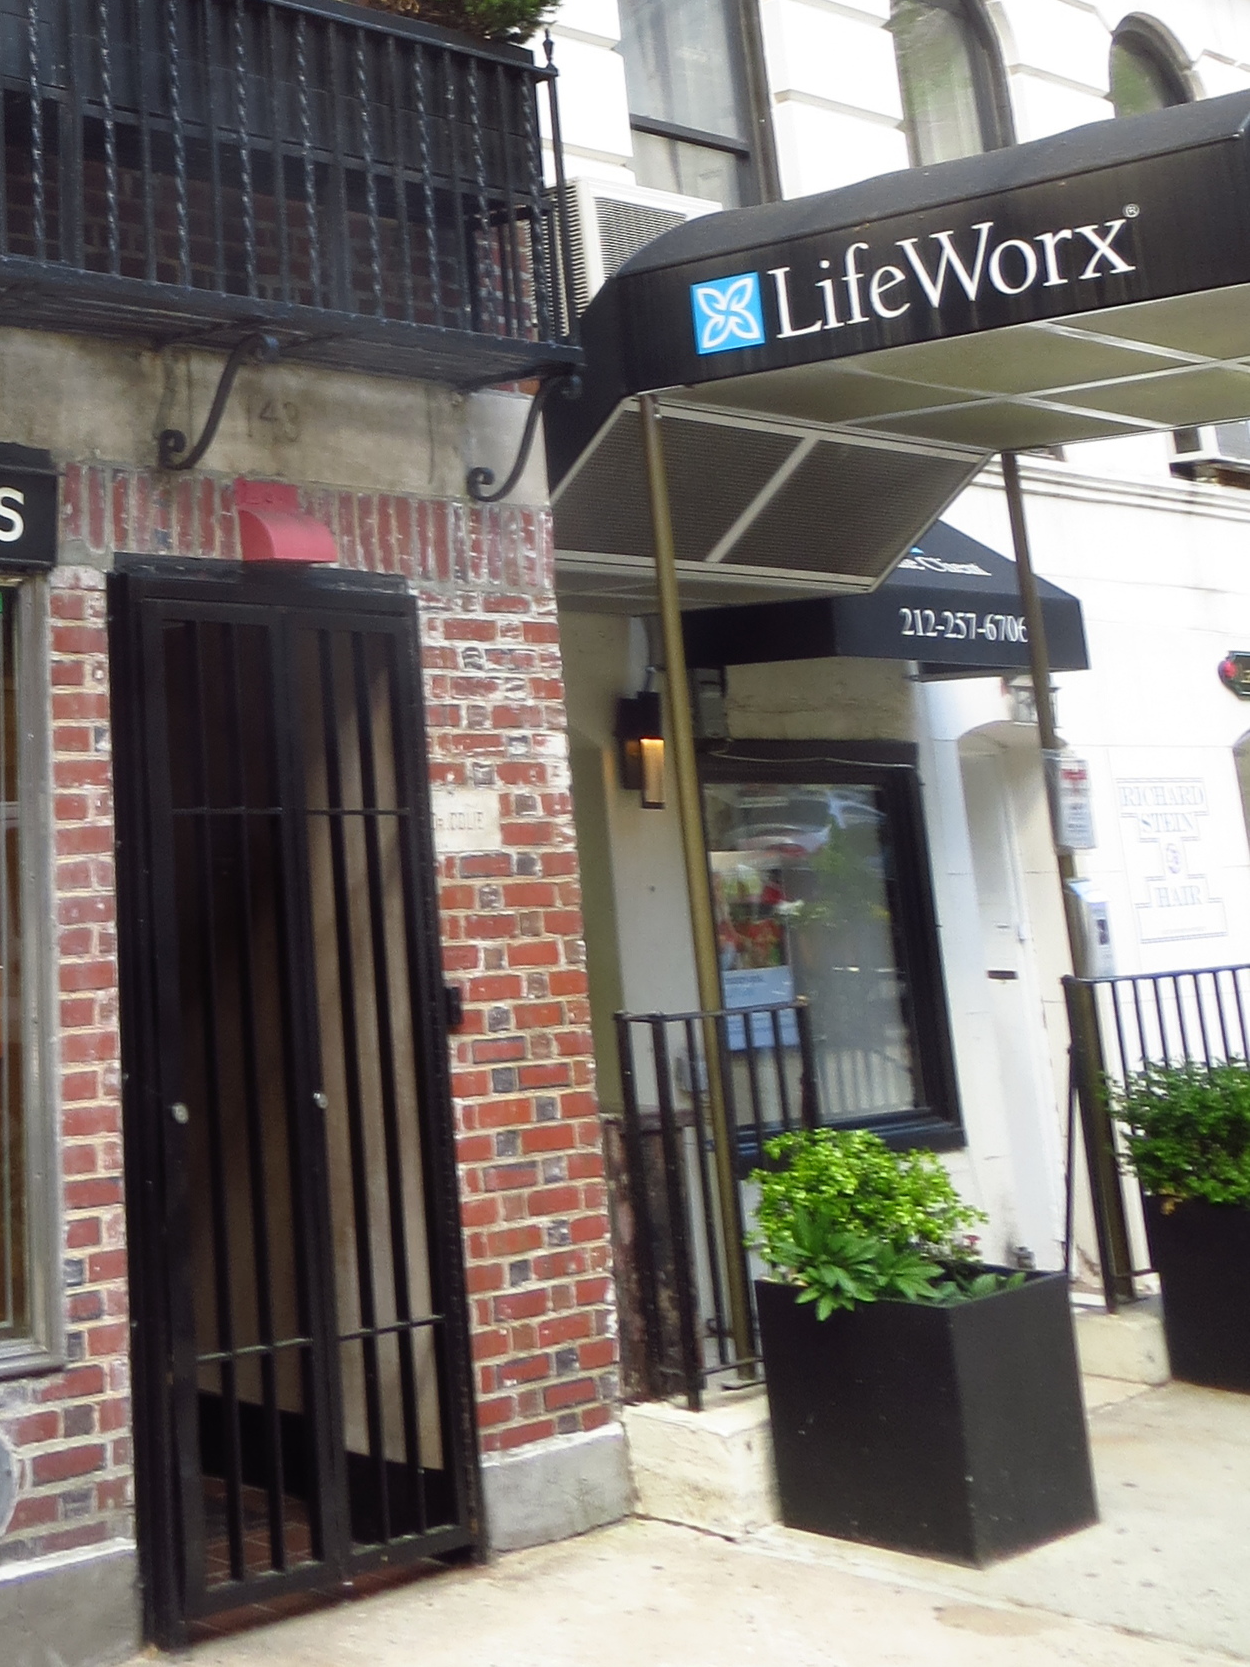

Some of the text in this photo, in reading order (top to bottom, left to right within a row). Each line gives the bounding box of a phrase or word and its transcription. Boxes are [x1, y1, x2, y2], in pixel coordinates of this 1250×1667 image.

[1118, 786, 1204, 807] RICHARD
[1140, 813, 1194, 833] STEIN
[1155, 885, 1203, 908] HAIR
